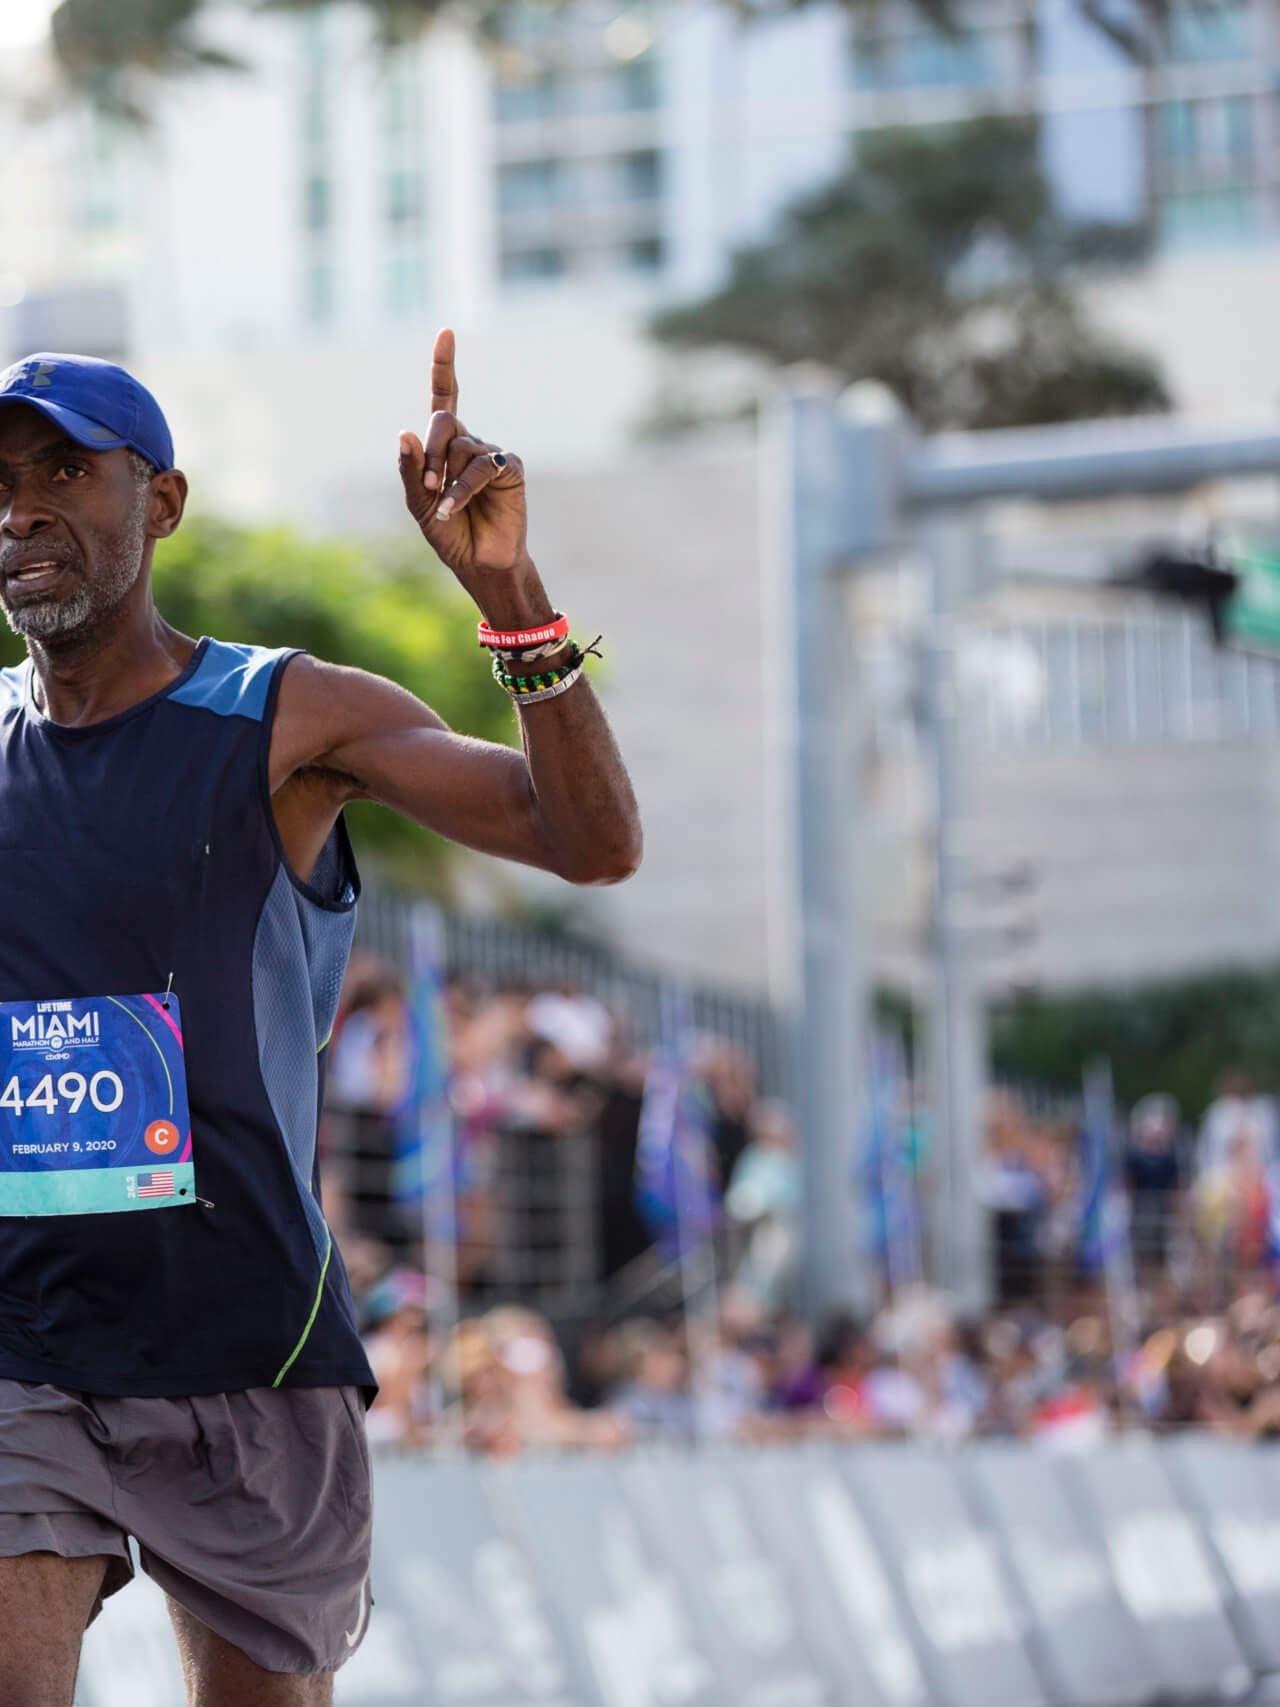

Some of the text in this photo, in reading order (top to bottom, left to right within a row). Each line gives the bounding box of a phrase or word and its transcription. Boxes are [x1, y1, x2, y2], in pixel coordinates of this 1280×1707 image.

[517, 627, 556, 644] Change
[11, 1011, 99, 1040] MIAMI
[12, 1039, 50, 1048] MARATHON
[81, 1036, 99, 1044] HALF
[0, 1070, 124, 1116] 4490
[154, 1128, 169, 1145] C
[12, 1139, 117, 1155] FEBRUARY 9, 2020
